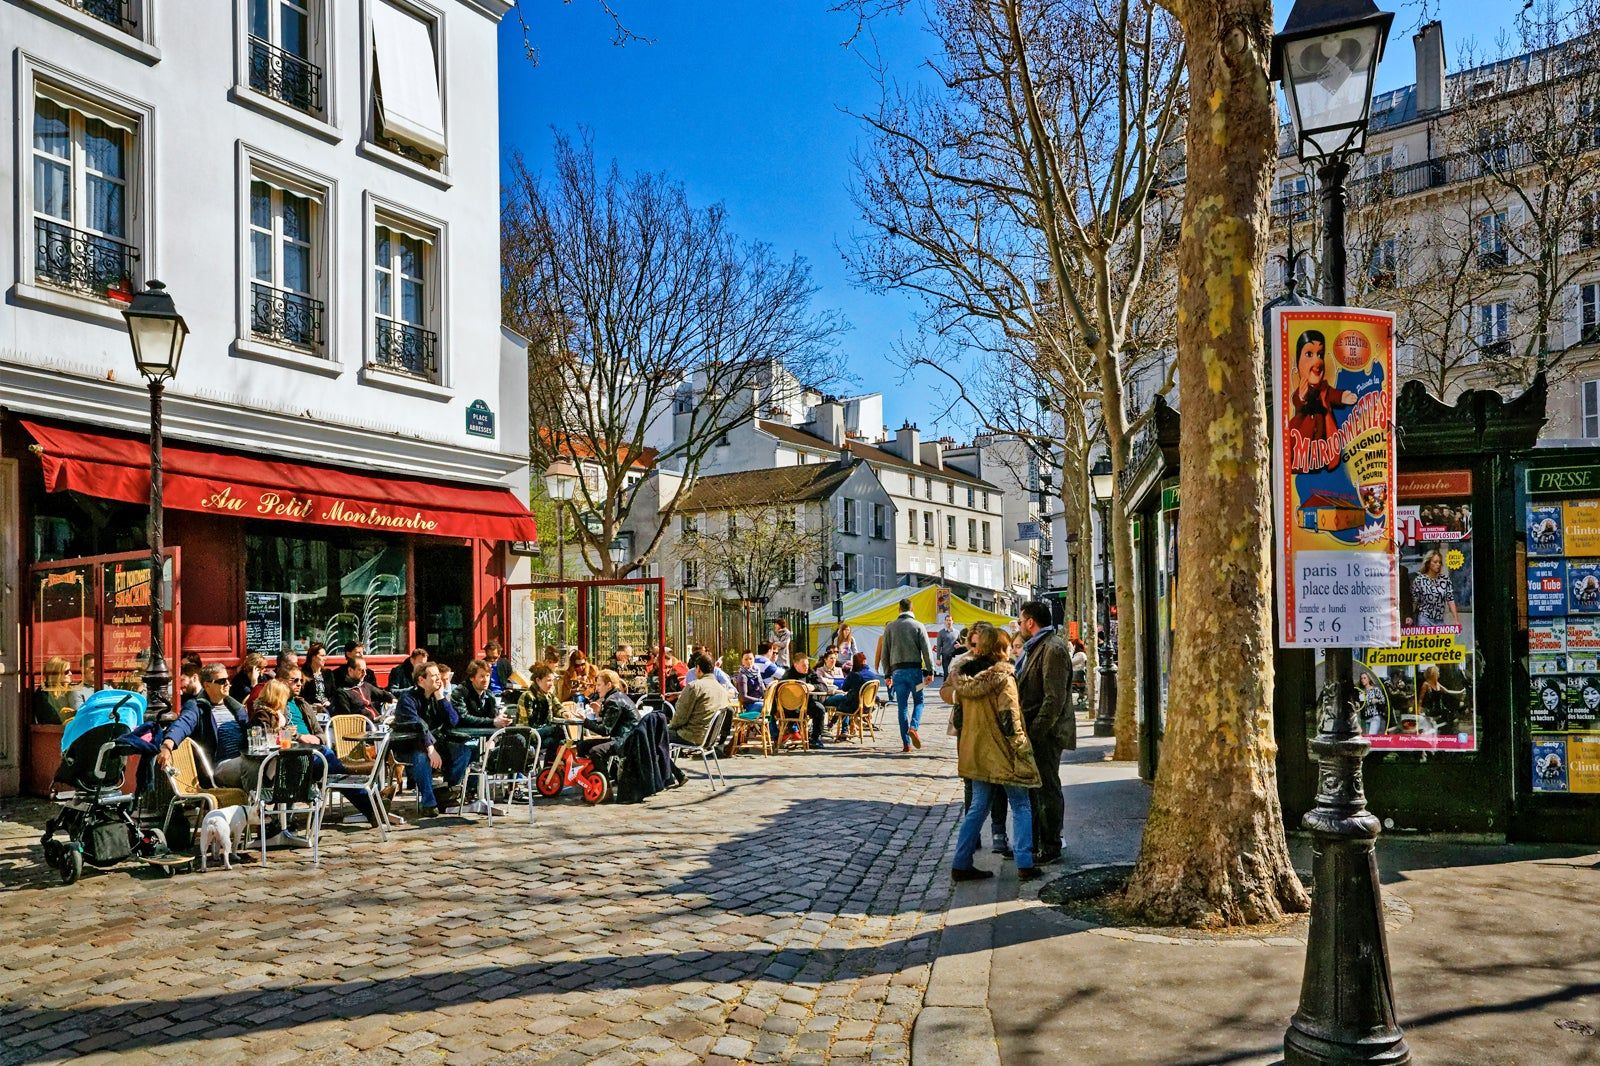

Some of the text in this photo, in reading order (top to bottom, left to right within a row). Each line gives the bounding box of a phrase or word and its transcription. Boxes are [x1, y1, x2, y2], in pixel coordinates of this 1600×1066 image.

[1350, 347, 1357, 356] DE
[472, 413, 488, 422] PLACE
[469, 424, 492, 434] ABBESSES
[1291, 390, 1388, 473] MARIONNETTES
[1342, 432, 1387, 463] GUIGNOL
[1354, 450, 1387, 468] ET MIMI
[1357, 461, 1388, 476] LA PETITE
[1362, 470, 1383, 481] SOURIS
[1539, 471, 1592, 491] PRESSE
[201, 487, 439, 530] Au Petit Montmartre
[1303, 563, 1337, 580] paris
[1347, 563, 1360, 577] 18
[1529, 561, 1559, 569] Society
[1302, 581, 1386, 599] place des abbesses
[1328, 604, 1347, 613] lundi
[1303, 616, 1313, 632] 5
[1318, 618, 1326, 631] et
[1331, 617, 1342, 632] 6
[1303, 635, 1340, 643] avril
[1407, 635, 1452, 649] histoire
[1369, 648, 1462, 663] d'amour secrète
